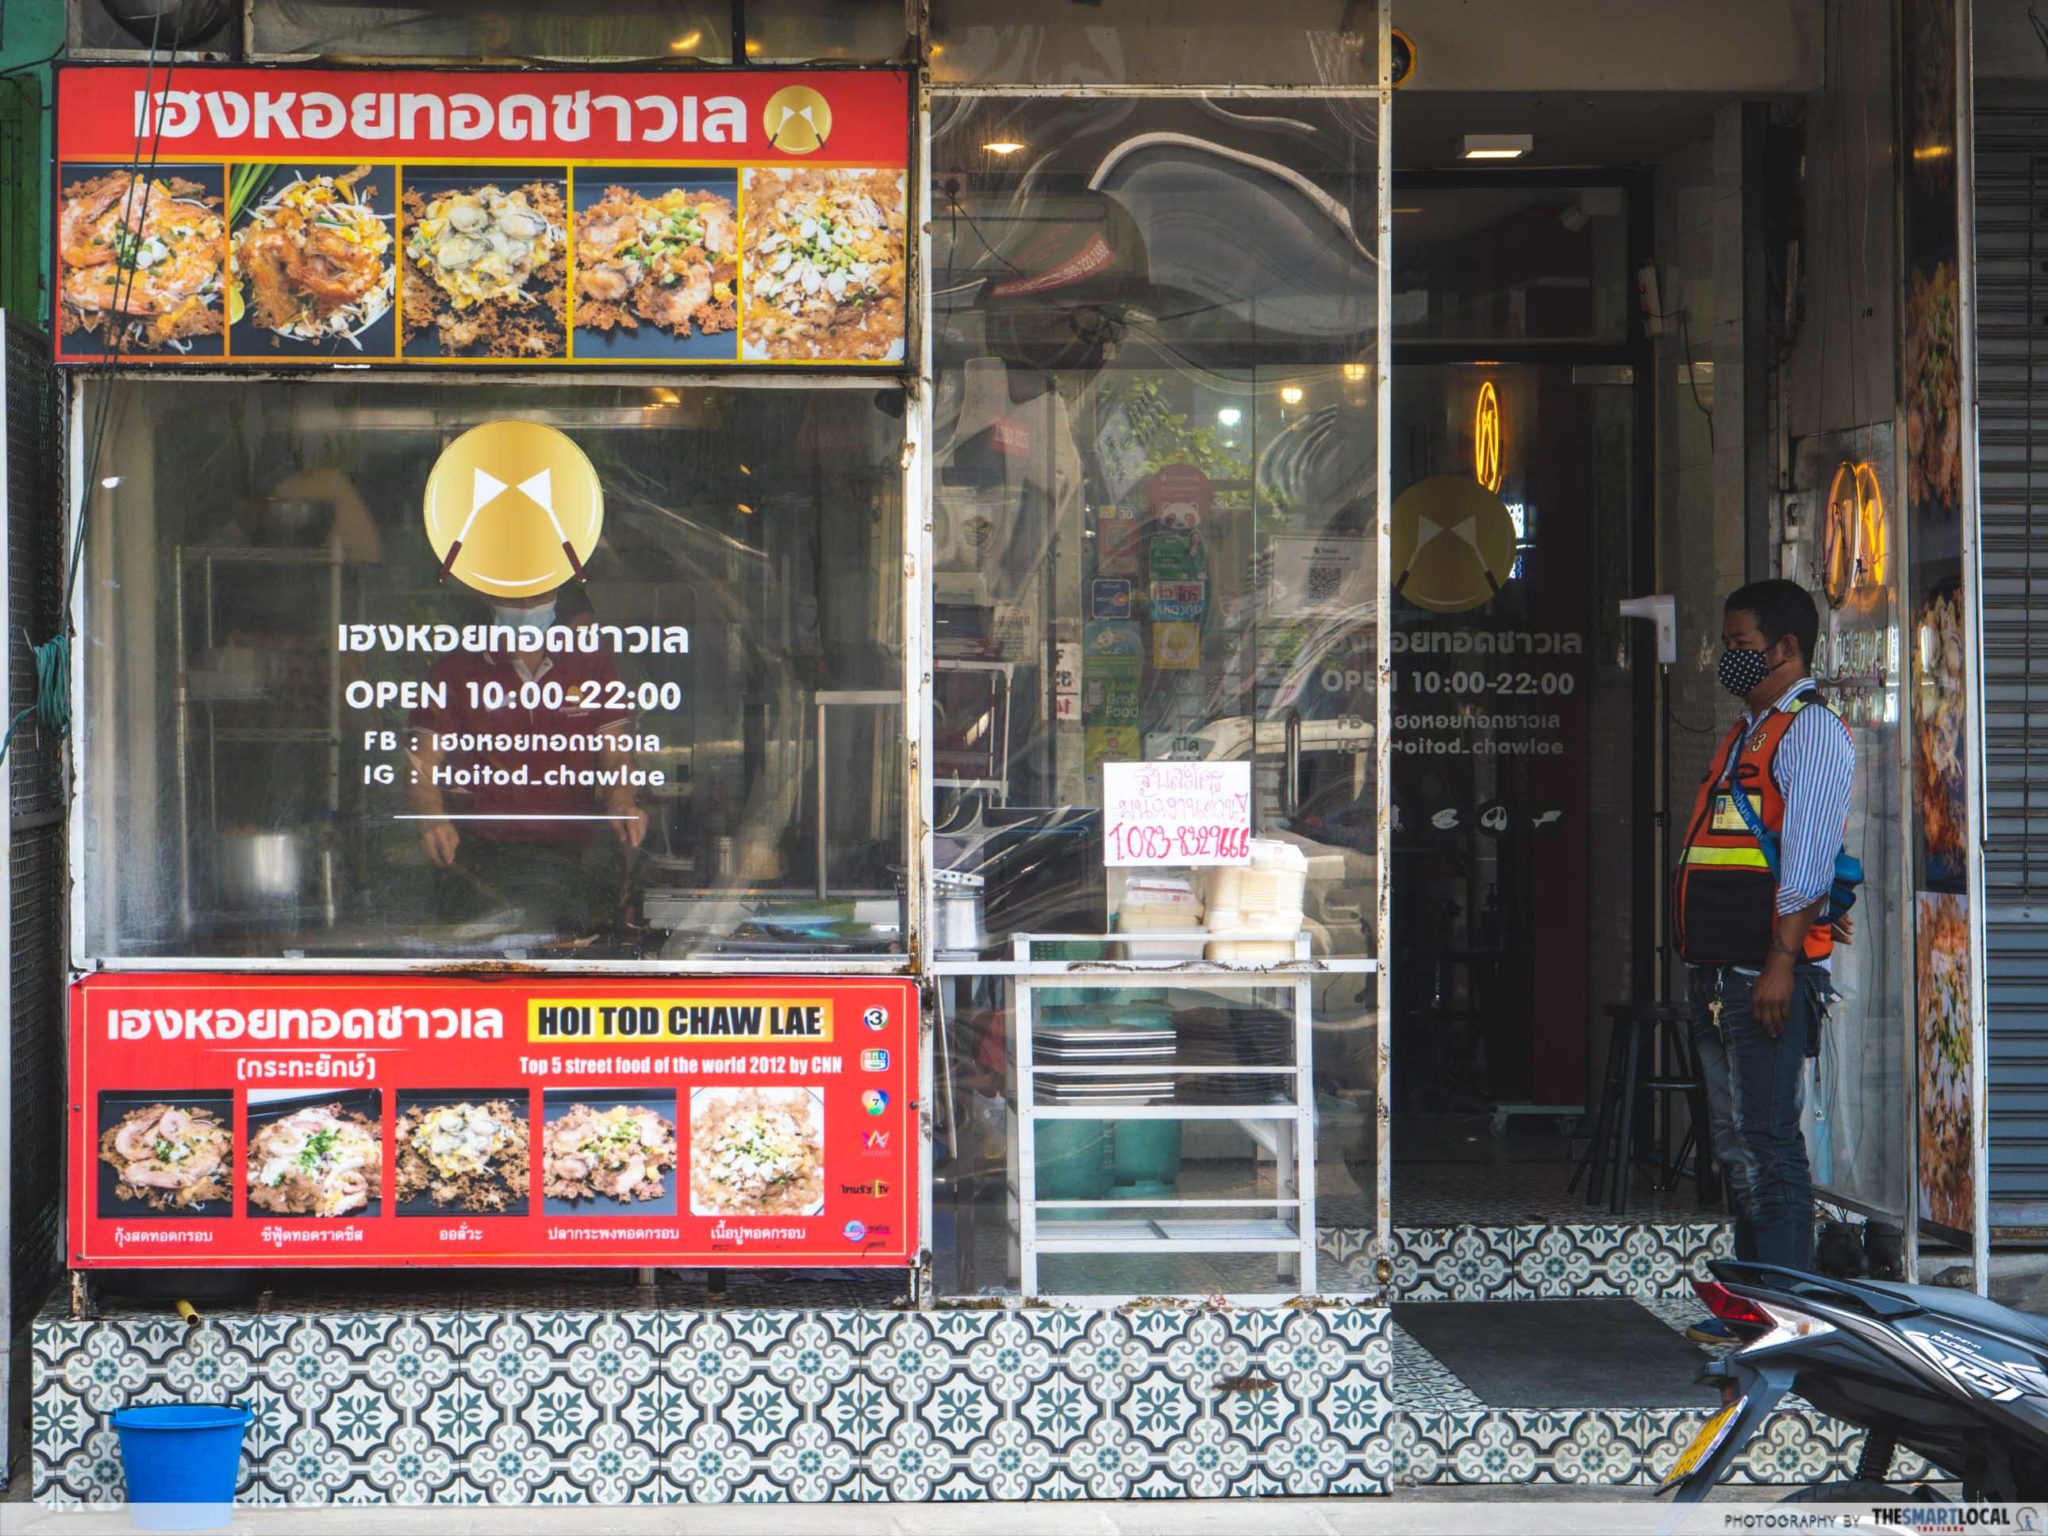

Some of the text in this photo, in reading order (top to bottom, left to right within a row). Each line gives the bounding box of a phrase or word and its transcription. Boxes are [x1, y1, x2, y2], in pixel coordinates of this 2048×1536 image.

[134, 89, 747, 142] เฮงหอยทอดชาวเล
[338, 623, 689, 654] เฮงหอยทอดชาวเล
[345, 680, 682, 710] OPEN 10:00-22:00
[1411, 671, 1575, 695] 10:00-22:00
[1106, 705, 1139, 717] Food
[1390, 713, 1561, 730] ฮงหอยทอดชาวเล
[364, 731, 660, 752] FB : เฮงหอยทอดชาวเล
[364, 764, 666, 786] IG : Hoitod_chawlae
[107, 1005, 503, 1040] เฮงหอยทอดชาวเล
[538, 1006, 823, 1037] HOI TOD CHAW LAE
[519, 1056, 842, 1075] Top 5 street food of the world 2012 by CNN
